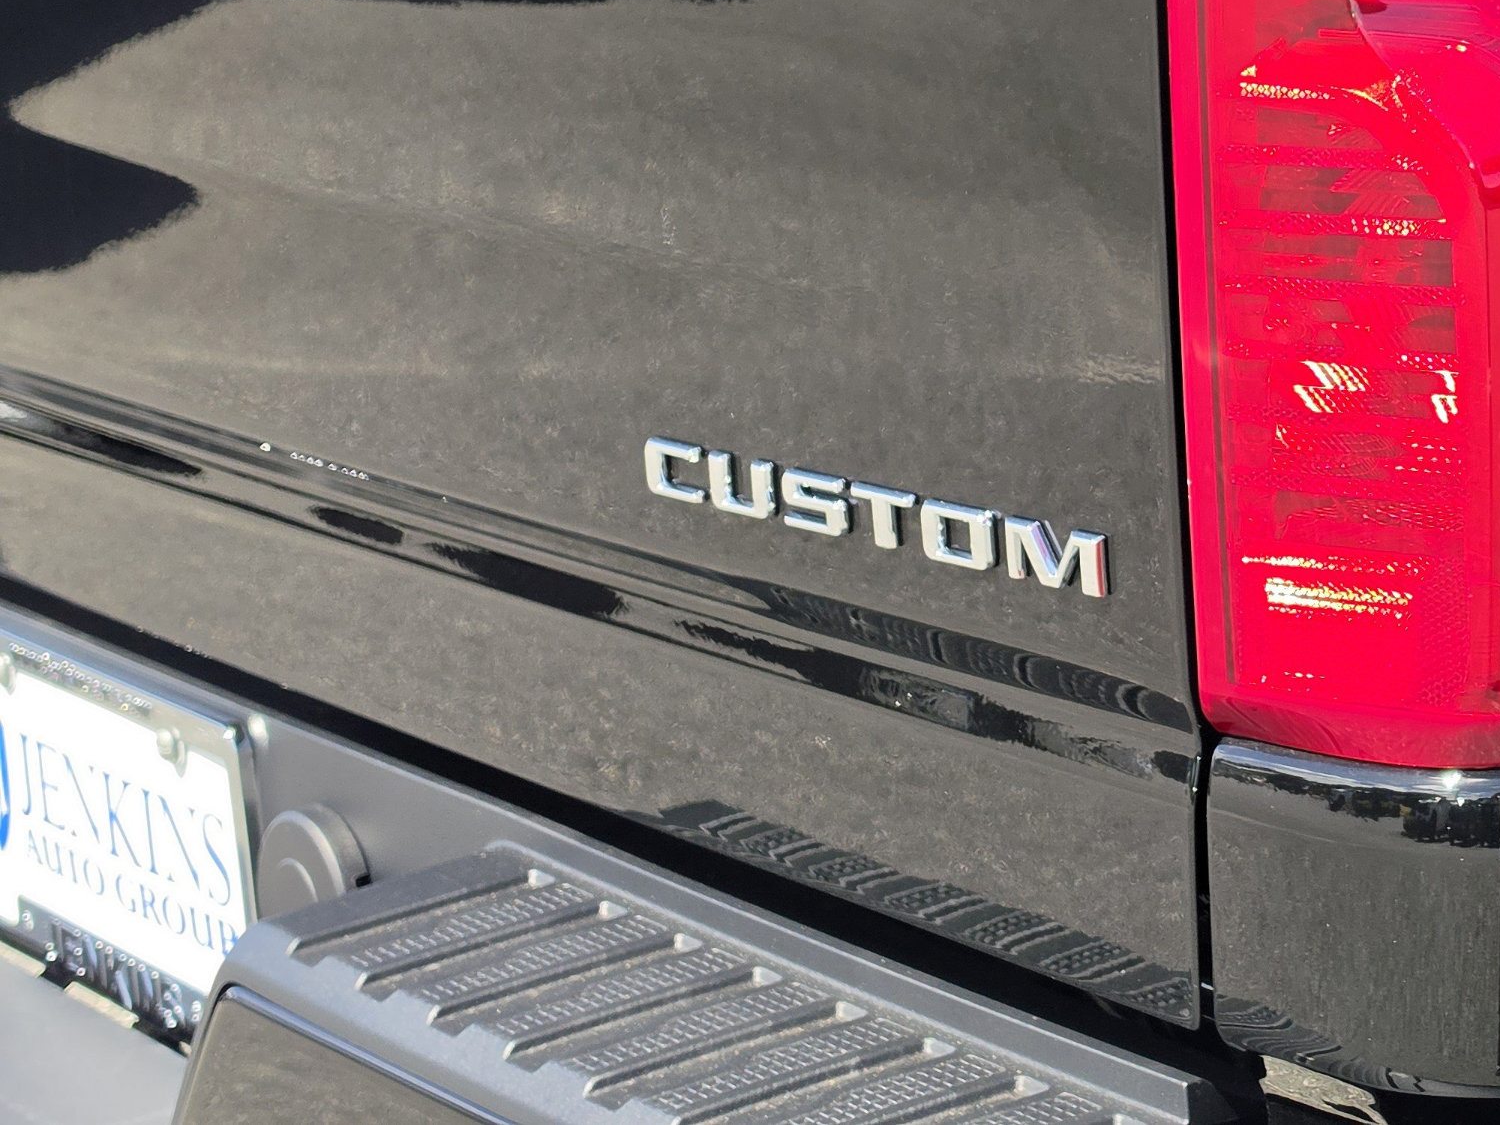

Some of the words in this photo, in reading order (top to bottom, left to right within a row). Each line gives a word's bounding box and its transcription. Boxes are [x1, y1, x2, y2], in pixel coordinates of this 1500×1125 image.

[644, 436, 1111, 598] CUSTOM
[20, 732, 232, 907] JENKINS
[27, 829, 105, 896] AUTO
[115, 873, 240, 957] GROUP
